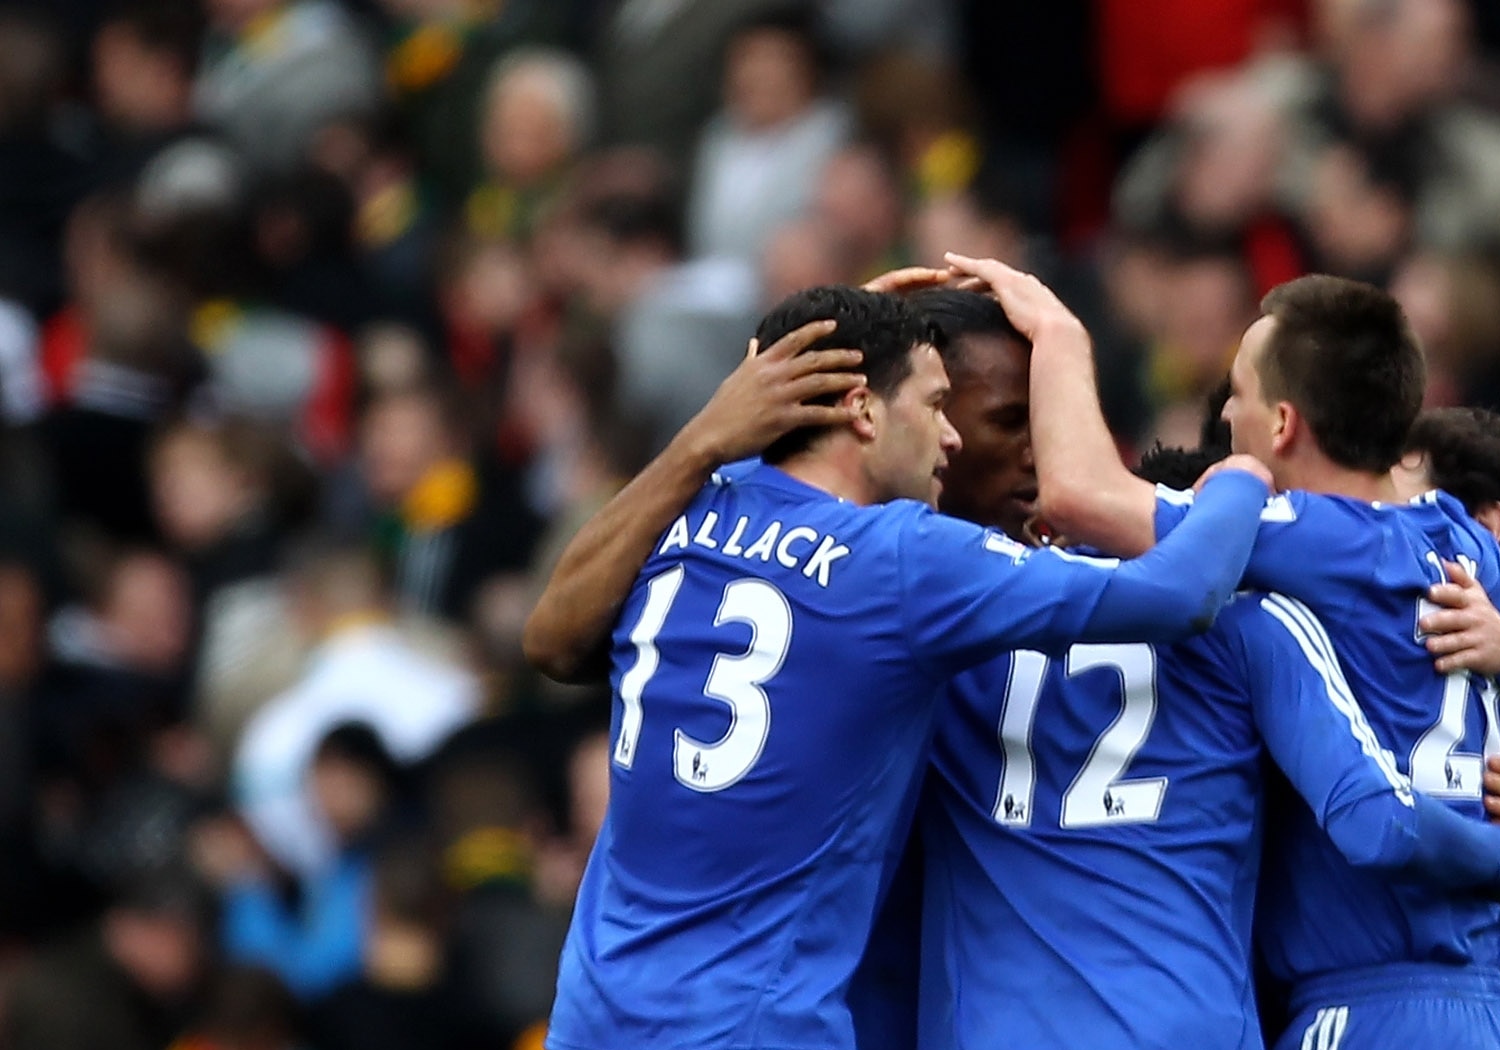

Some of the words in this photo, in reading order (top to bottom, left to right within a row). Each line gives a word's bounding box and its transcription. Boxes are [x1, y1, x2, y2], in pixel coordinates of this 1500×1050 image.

[659, 512, 850, 588] ALLACK
[613, 563, 793, 793] 13
[992, 642, 1169, 829] 12
